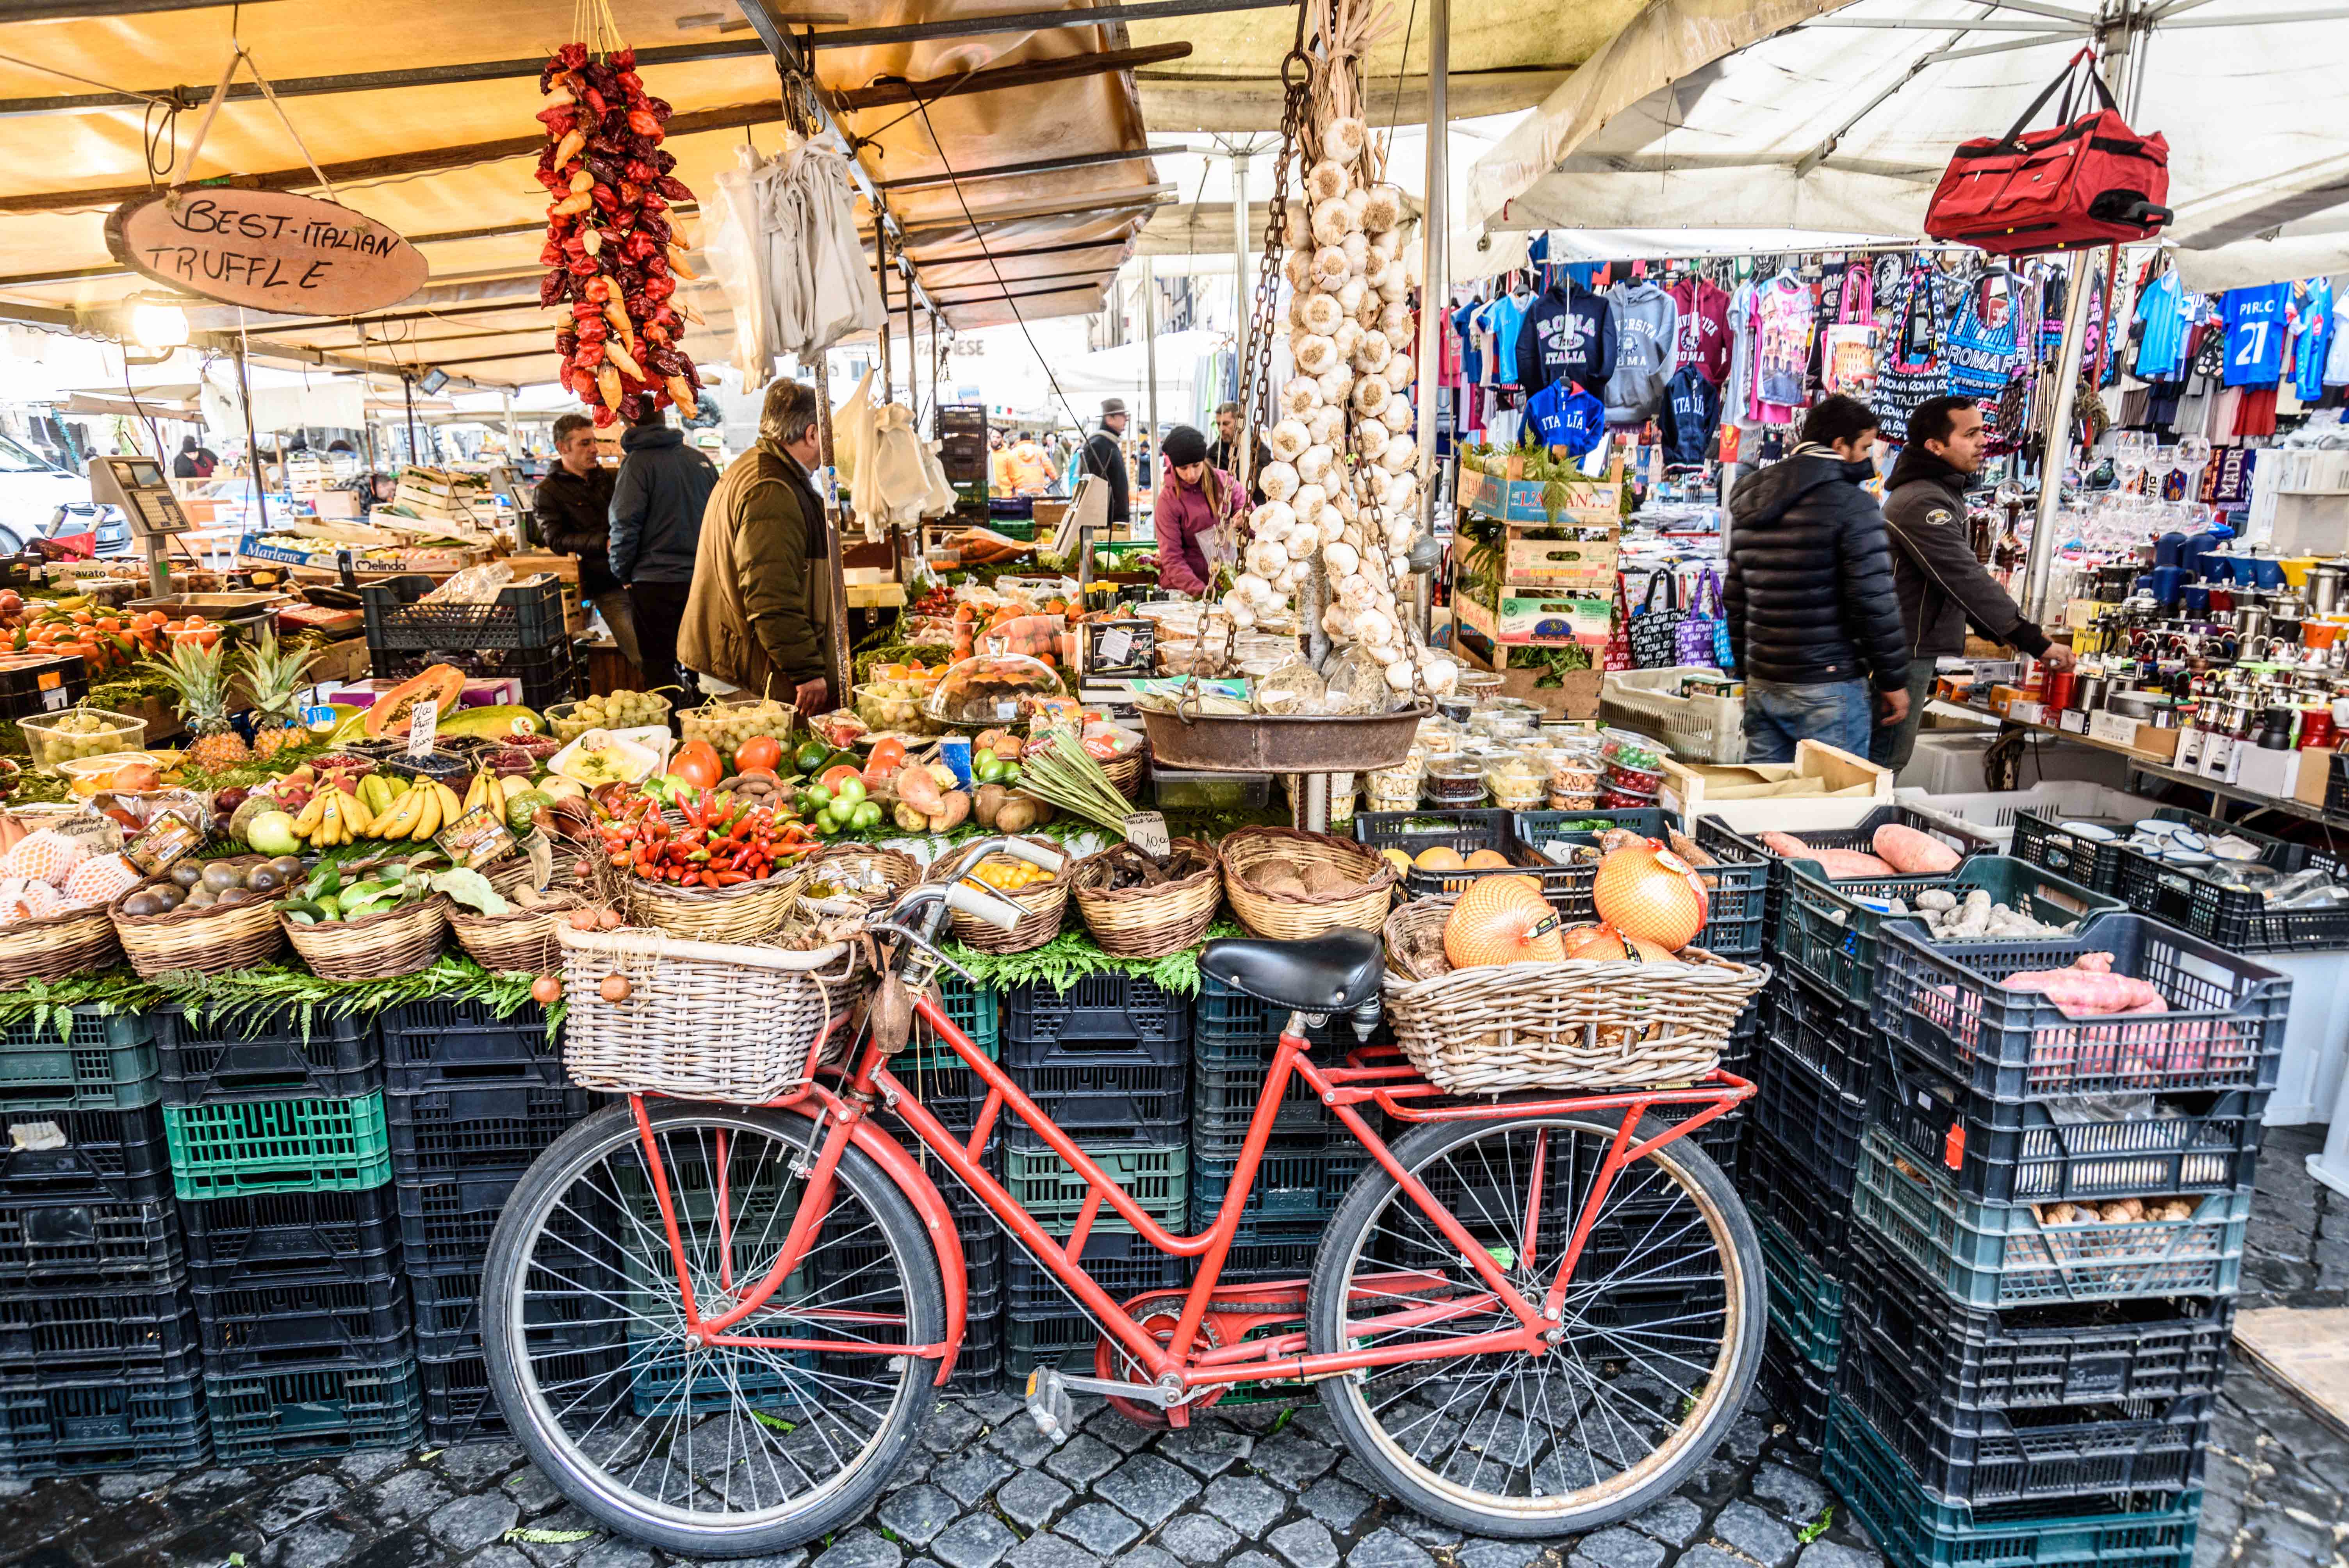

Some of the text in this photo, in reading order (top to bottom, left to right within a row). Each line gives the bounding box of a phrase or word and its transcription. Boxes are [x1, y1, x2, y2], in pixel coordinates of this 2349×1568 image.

[146, 247, 333, 289] TRUFFLE
[2235, 321, 2269, 366] 21
[1545, 351, 1587, 365] ITALIA
[1616, 356, 1647, 366] OMA
[1948, 345, 2000, 373] ROMA
[1885, 379, 1907, 391] ROMA
[1909, 380, 1936, 392] ROMA
[1674, 395, 1704, 416] ITALIA
[1542, 414, 1583, 431] ITALIA
[2217, 448, 2245, 499] MADR
[1520, 490, 1610, 508] L'AAN
[245, 543, 302, 563] Marlene
[355, 559, 406, 571] Melinda
[1653, 613, 1668, 624] ROMA
[1644, 625, 1660, 634] ROMA
